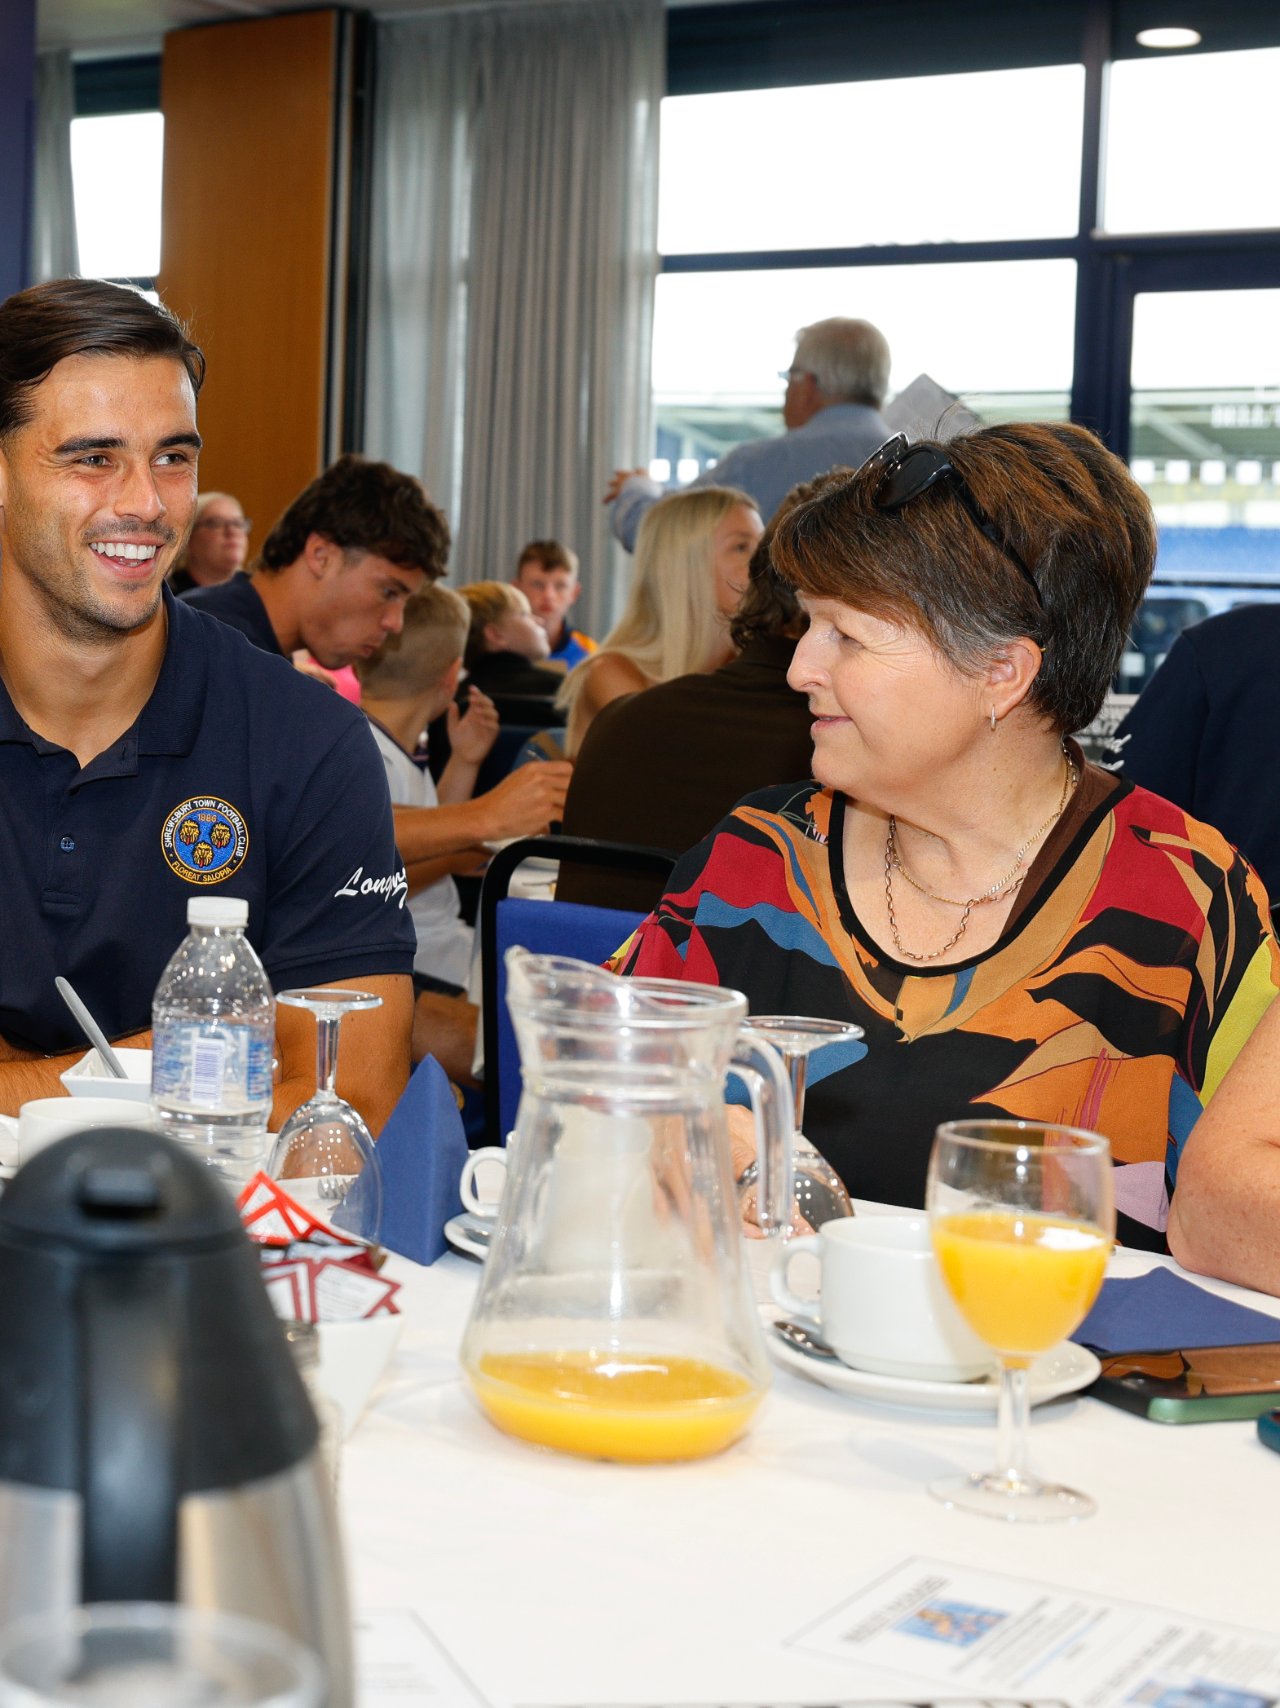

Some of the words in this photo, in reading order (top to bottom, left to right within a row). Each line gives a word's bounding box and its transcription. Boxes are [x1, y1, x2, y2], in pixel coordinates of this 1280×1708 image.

[198, 813, 217, 822] 1886
[164, 801, 193, 848] SHREWSBURY
[216, 802, 245, 836] FOOTBALL
[236, 836, 246, 857] CLUB
[172, 861, 200, 881] FLOREAT
[202, 867, 233, 882] SALOPIA
